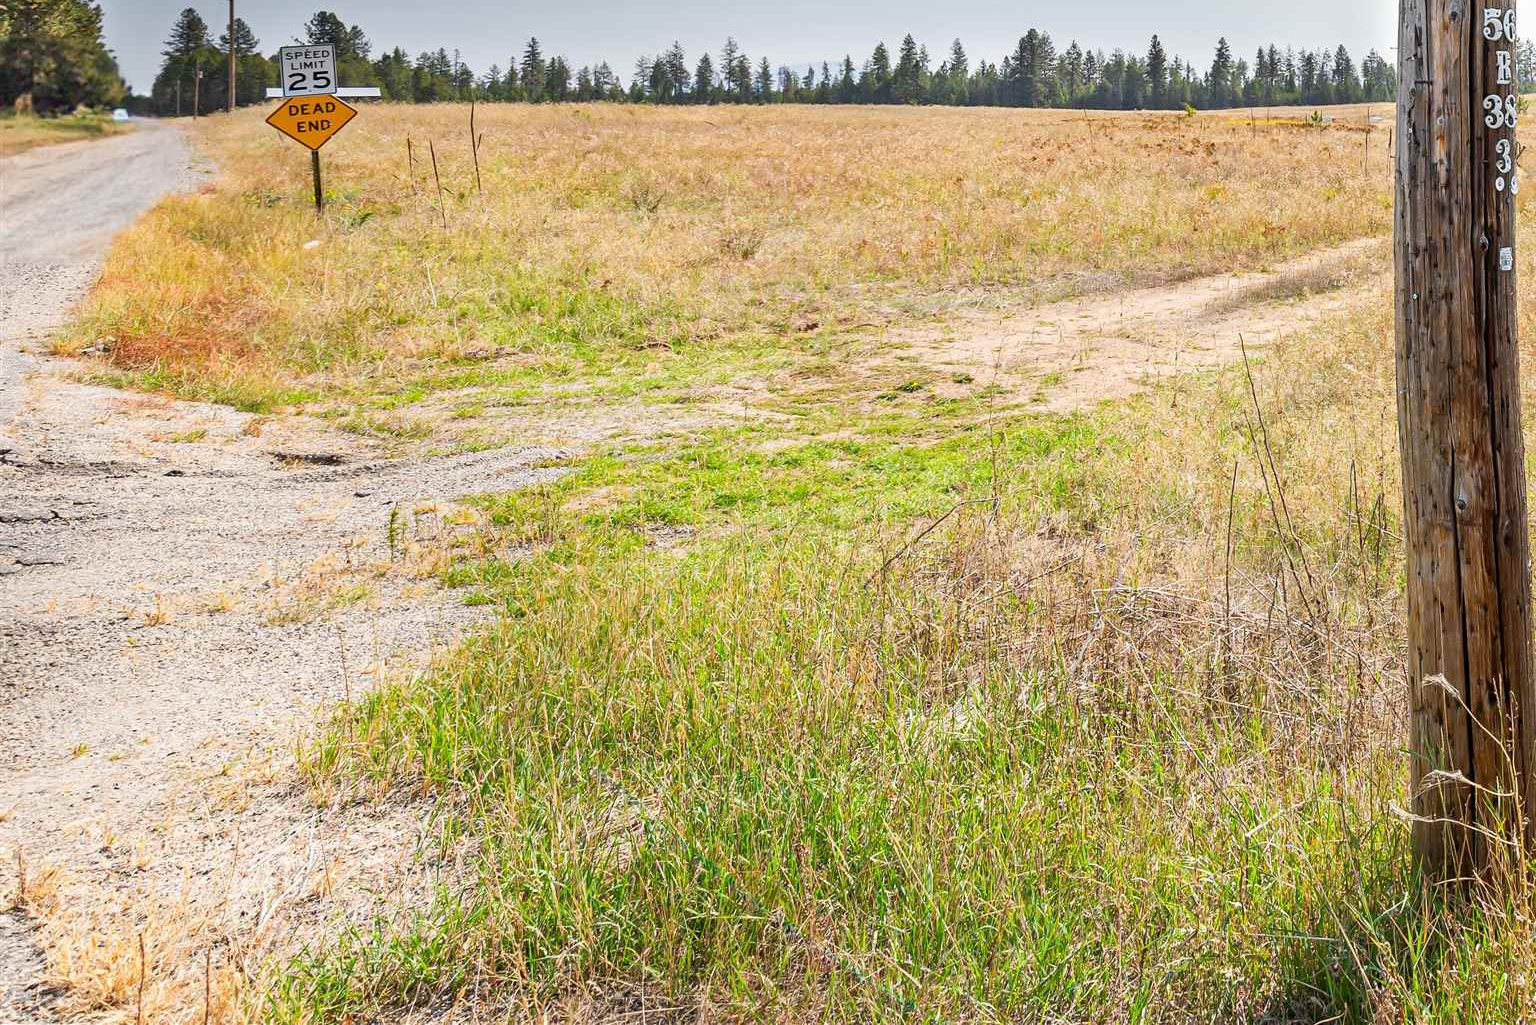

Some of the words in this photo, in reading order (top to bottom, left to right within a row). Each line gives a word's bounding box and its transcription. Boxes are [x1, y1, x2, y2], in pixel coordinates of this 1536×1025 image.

[286, 50, 330, 60] SPEED
[291, 61, 325, 70] LIMIT
[288, 71, 331, 91] 25
[289, 102, 336, 116] DEAD
[1483, 94, 1517, 129] 38
[297, 120, 331, 132] END
[1496, 139, 1512, 173] 3
